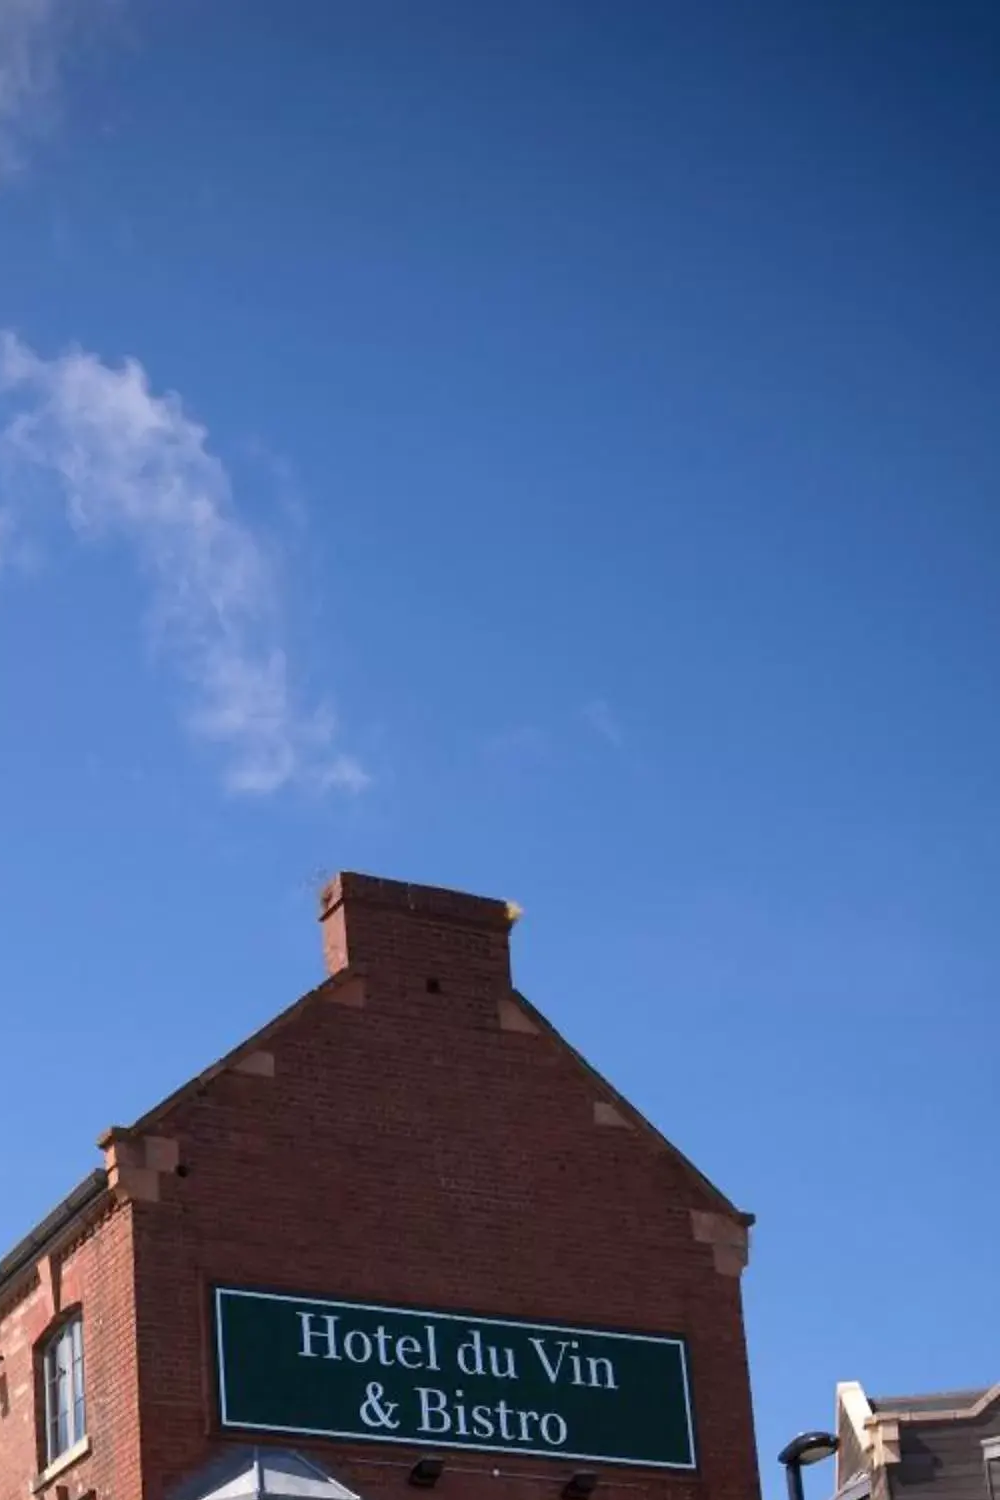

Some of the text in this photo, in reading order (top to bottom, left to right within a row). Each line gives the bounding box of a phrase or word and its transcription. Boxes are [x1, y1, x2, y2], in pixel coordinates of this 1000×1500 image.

[296, 1312, 618, 1389] Hotel du Vin
[360, 1381, 568, 1445] & Bistro
